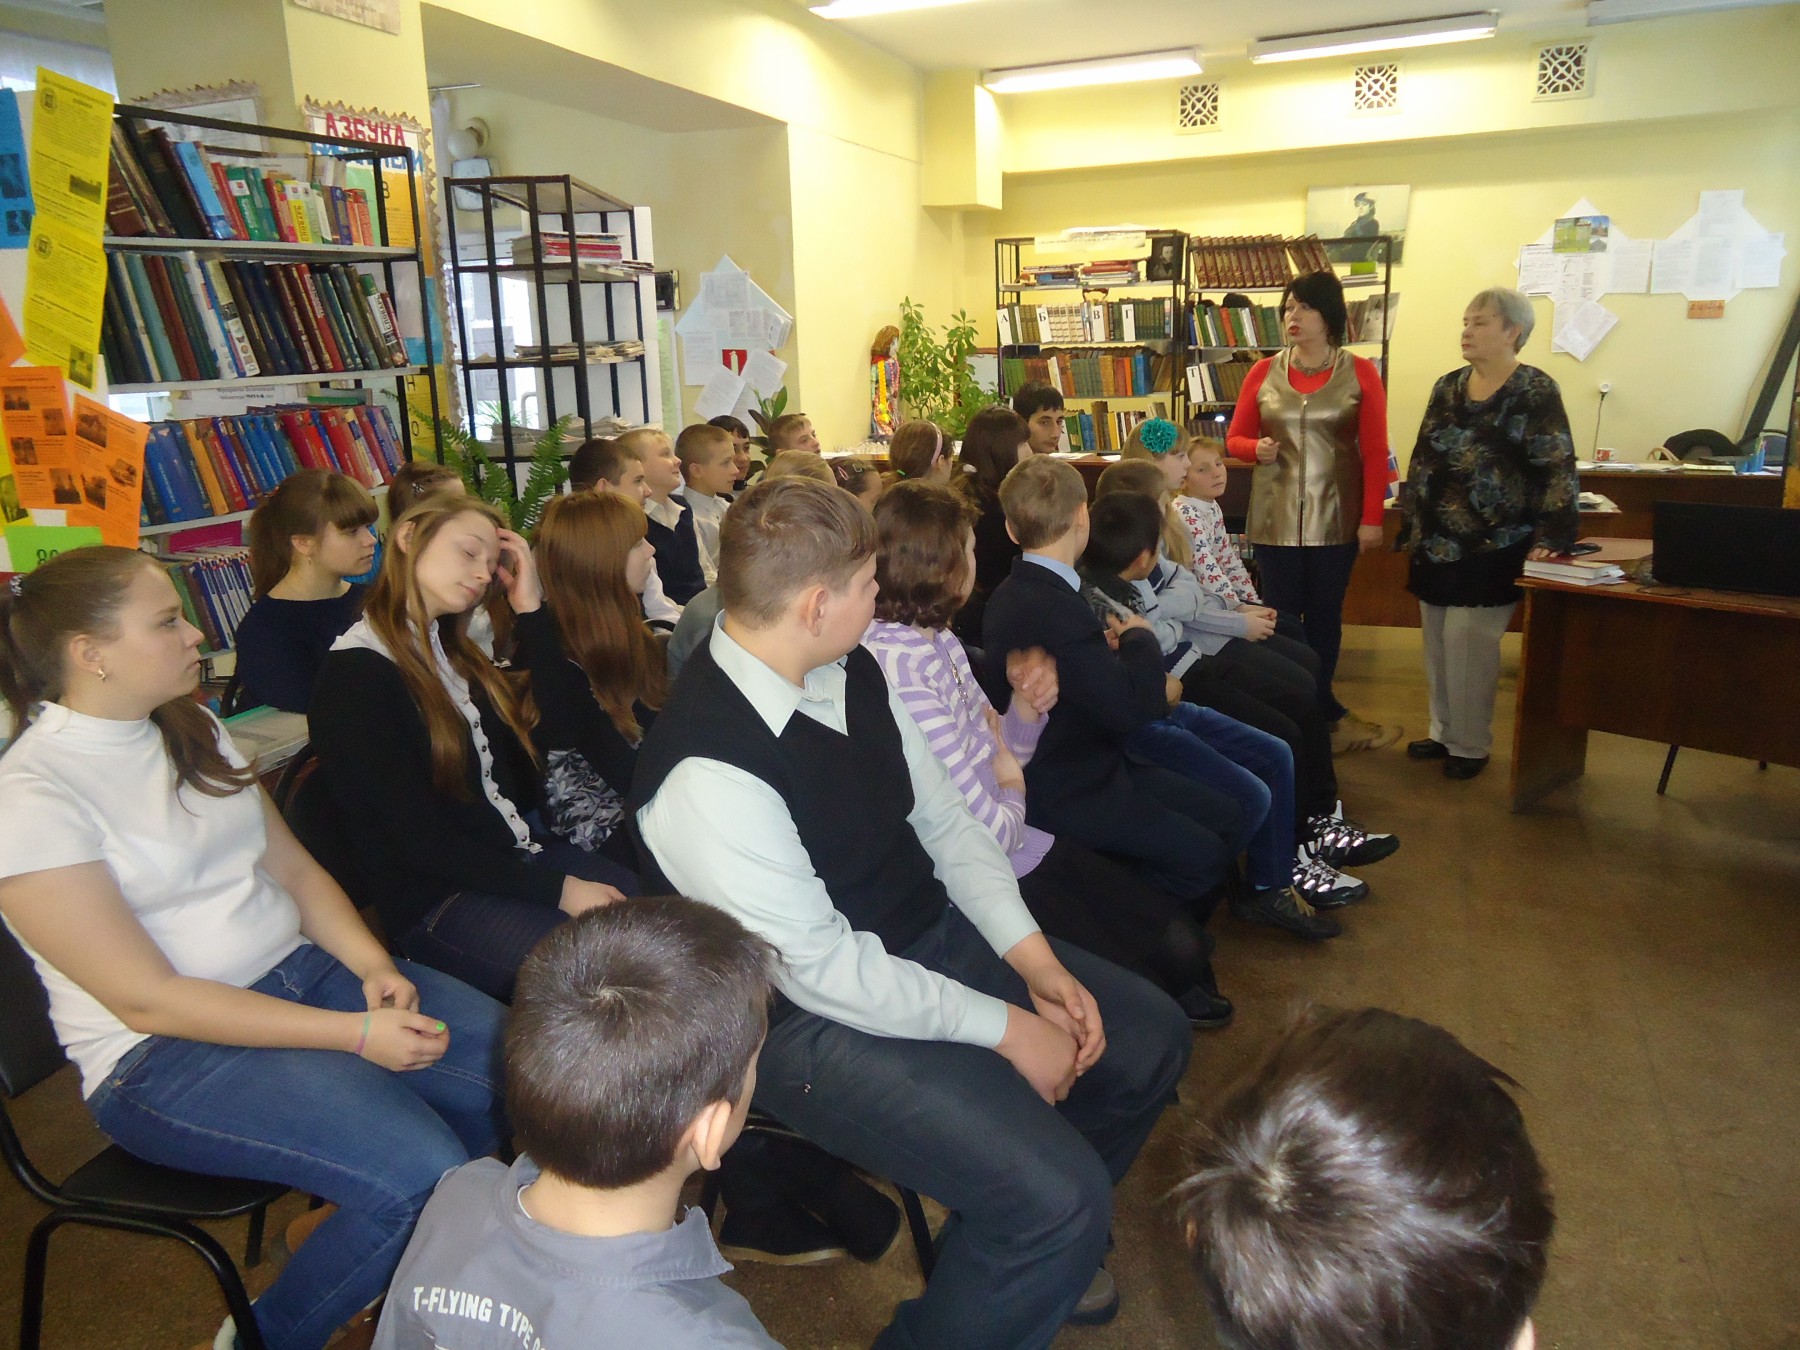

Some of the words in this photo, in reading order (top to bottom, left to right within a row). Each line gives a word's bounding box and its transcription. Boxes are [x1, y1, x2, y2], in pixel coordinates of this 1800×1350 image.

[326, 112, 406, 147] АЗБУКА
[1001, 314, 1009, 324] А
[1038, 312, 1047, 322] Б
[1093, 310, 1101, 320] В
[1125, 309, 1133, 319] Г
[1188, 368, 1197, 378] Т
[413, 1286, 493, 1323] T-FLYING
[500, 1302, 534, 1350] TYPE
